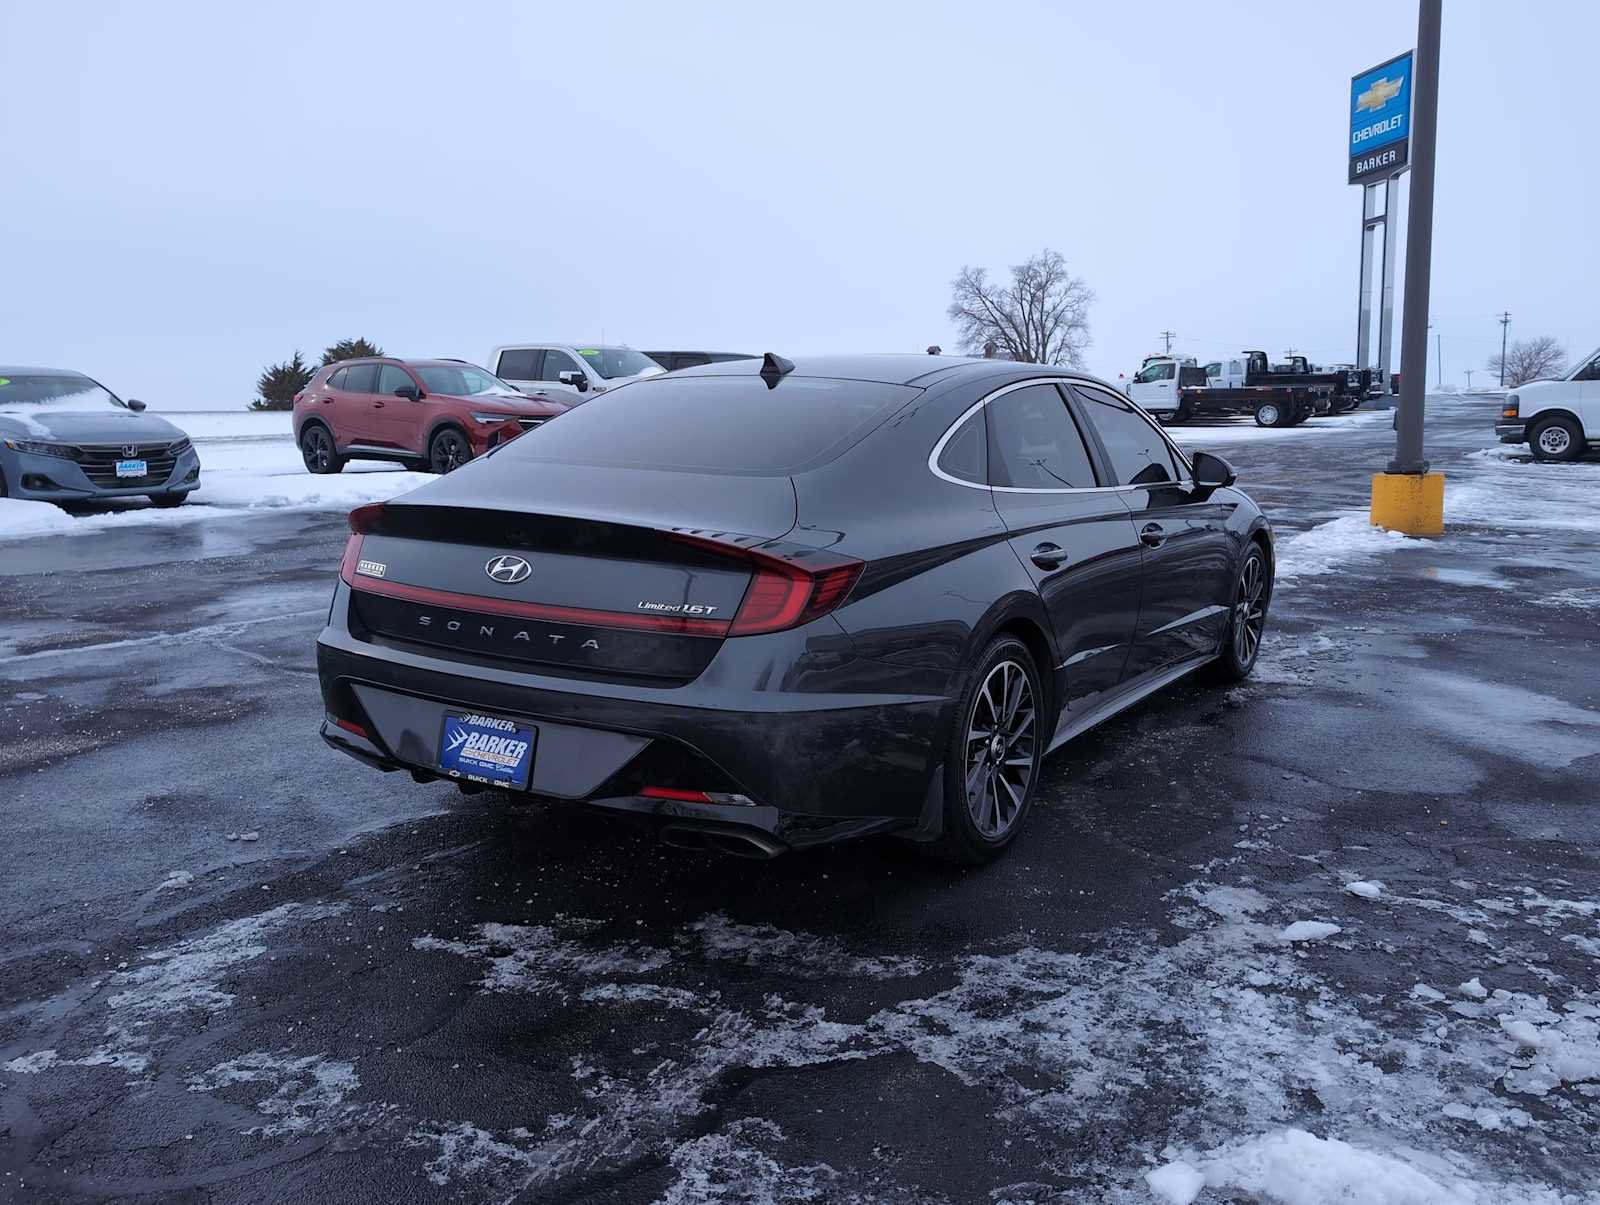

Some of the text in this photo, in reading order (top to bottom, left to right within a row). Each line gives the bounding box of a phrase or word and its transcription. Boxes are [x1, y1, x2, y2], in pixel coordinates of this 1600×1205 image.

[1352, 114, 1403, 144] CHEVROLET
[1356, 150, 1396, 174] BARKER
[637, 600, 680, 612] Limited
[418, 615, 600, 650] SONATA
[468, 714, 514, 732] BARKER
[465, 731, 528, 759] BARKER
[467, 774, 511, 788] BUICK GMC
